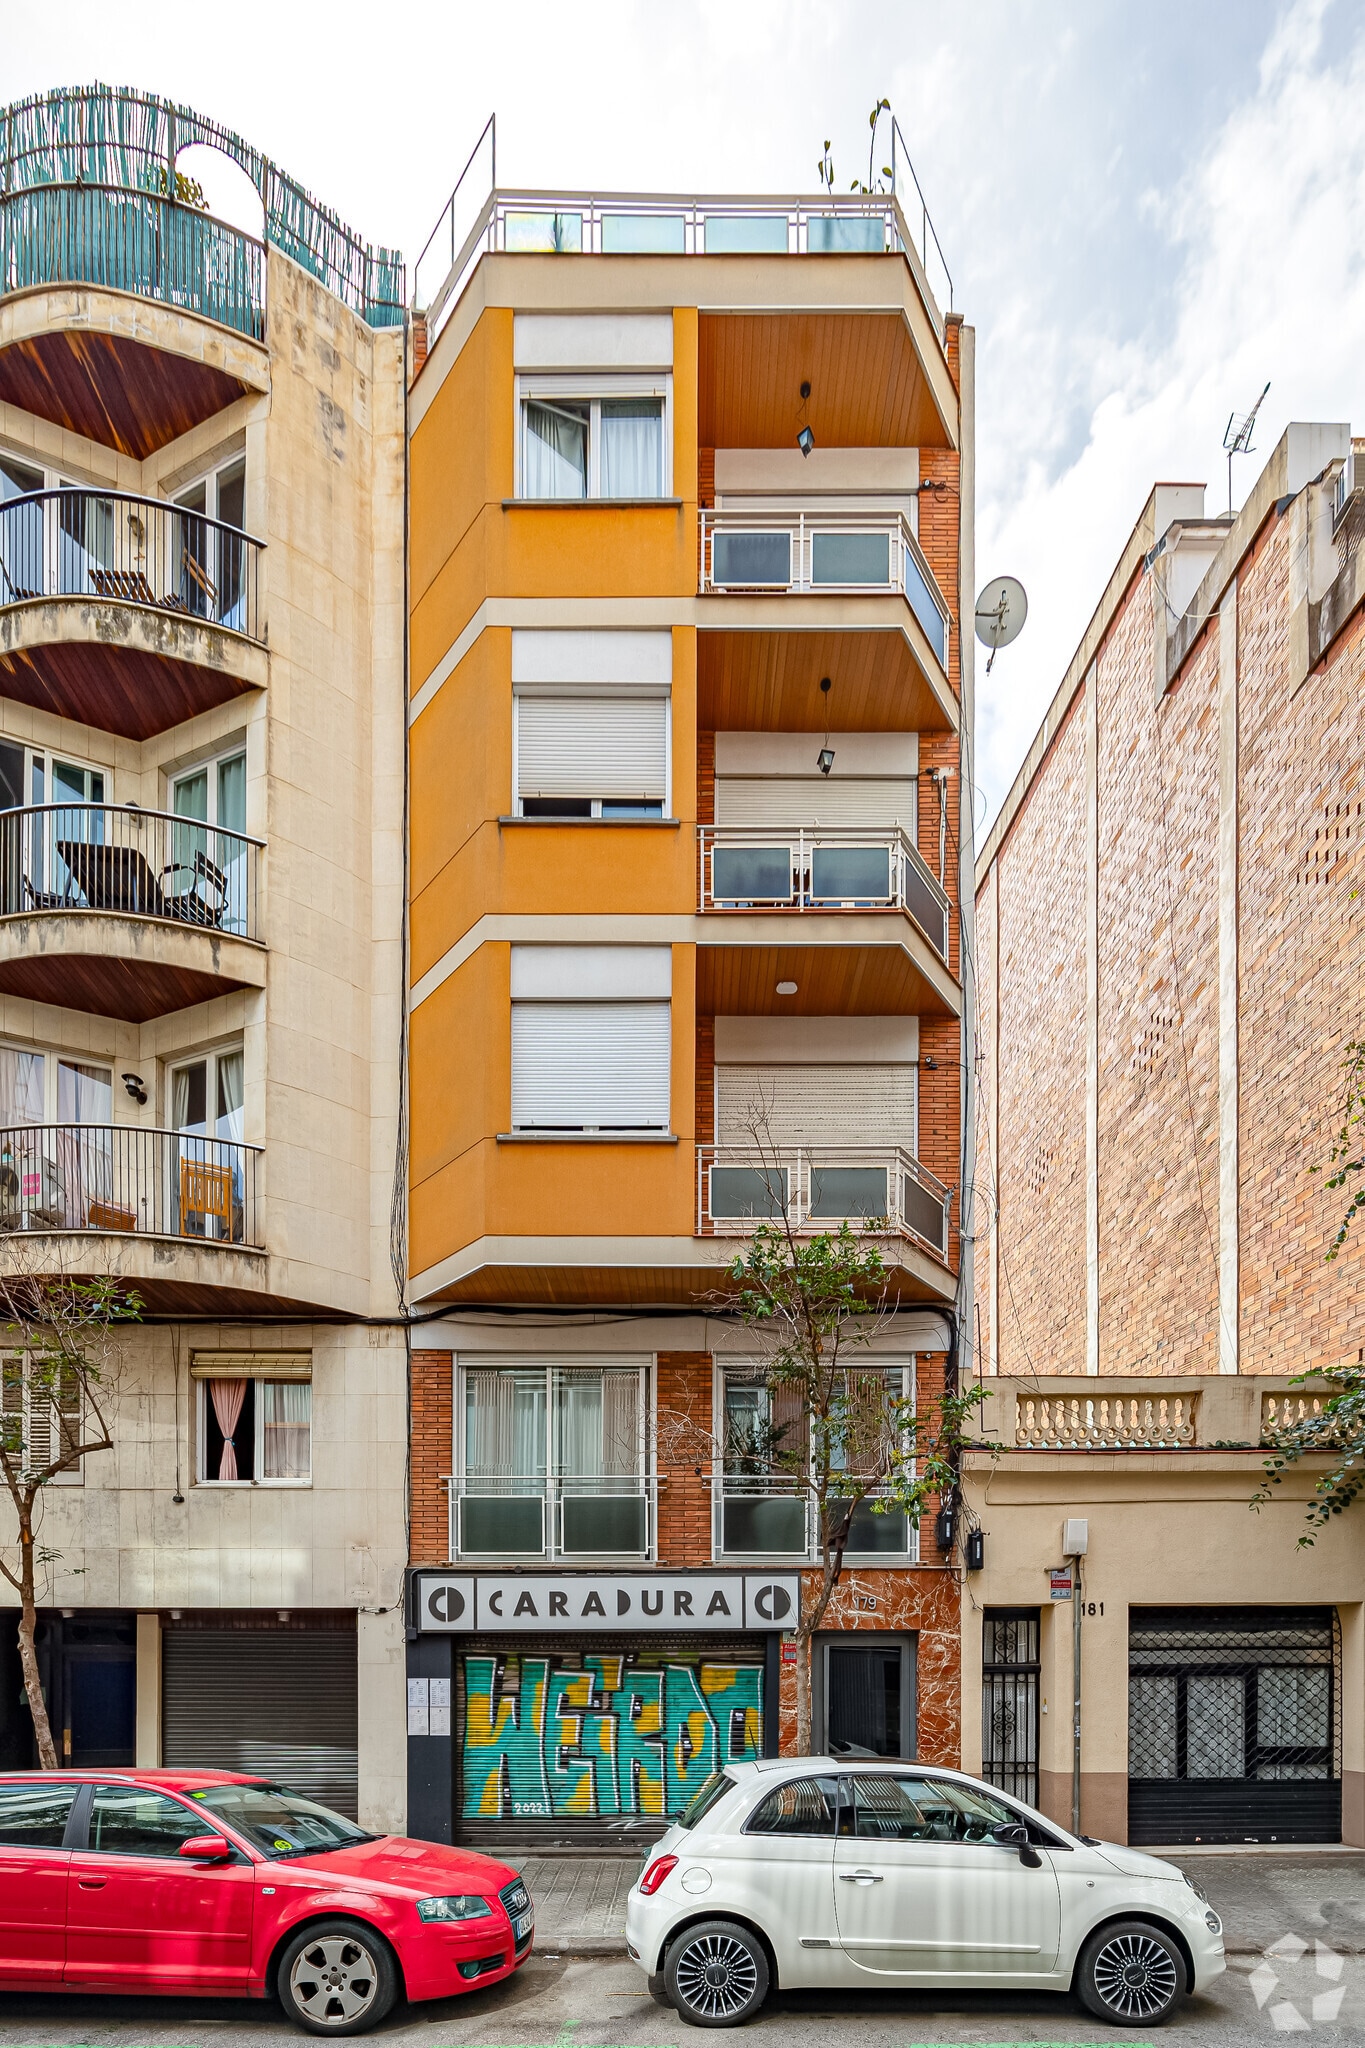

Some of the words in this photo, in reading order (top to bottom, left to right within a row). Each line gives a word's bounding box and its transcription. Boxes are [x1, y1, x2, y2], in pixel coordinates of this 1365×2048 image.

[488, 1590, 732, 1617] CARADURA
[855, 1596, 877, 1610] 179
[1081, 1602, 1104, 1616] 181
[514, 1802, 545, 1815] 2022
